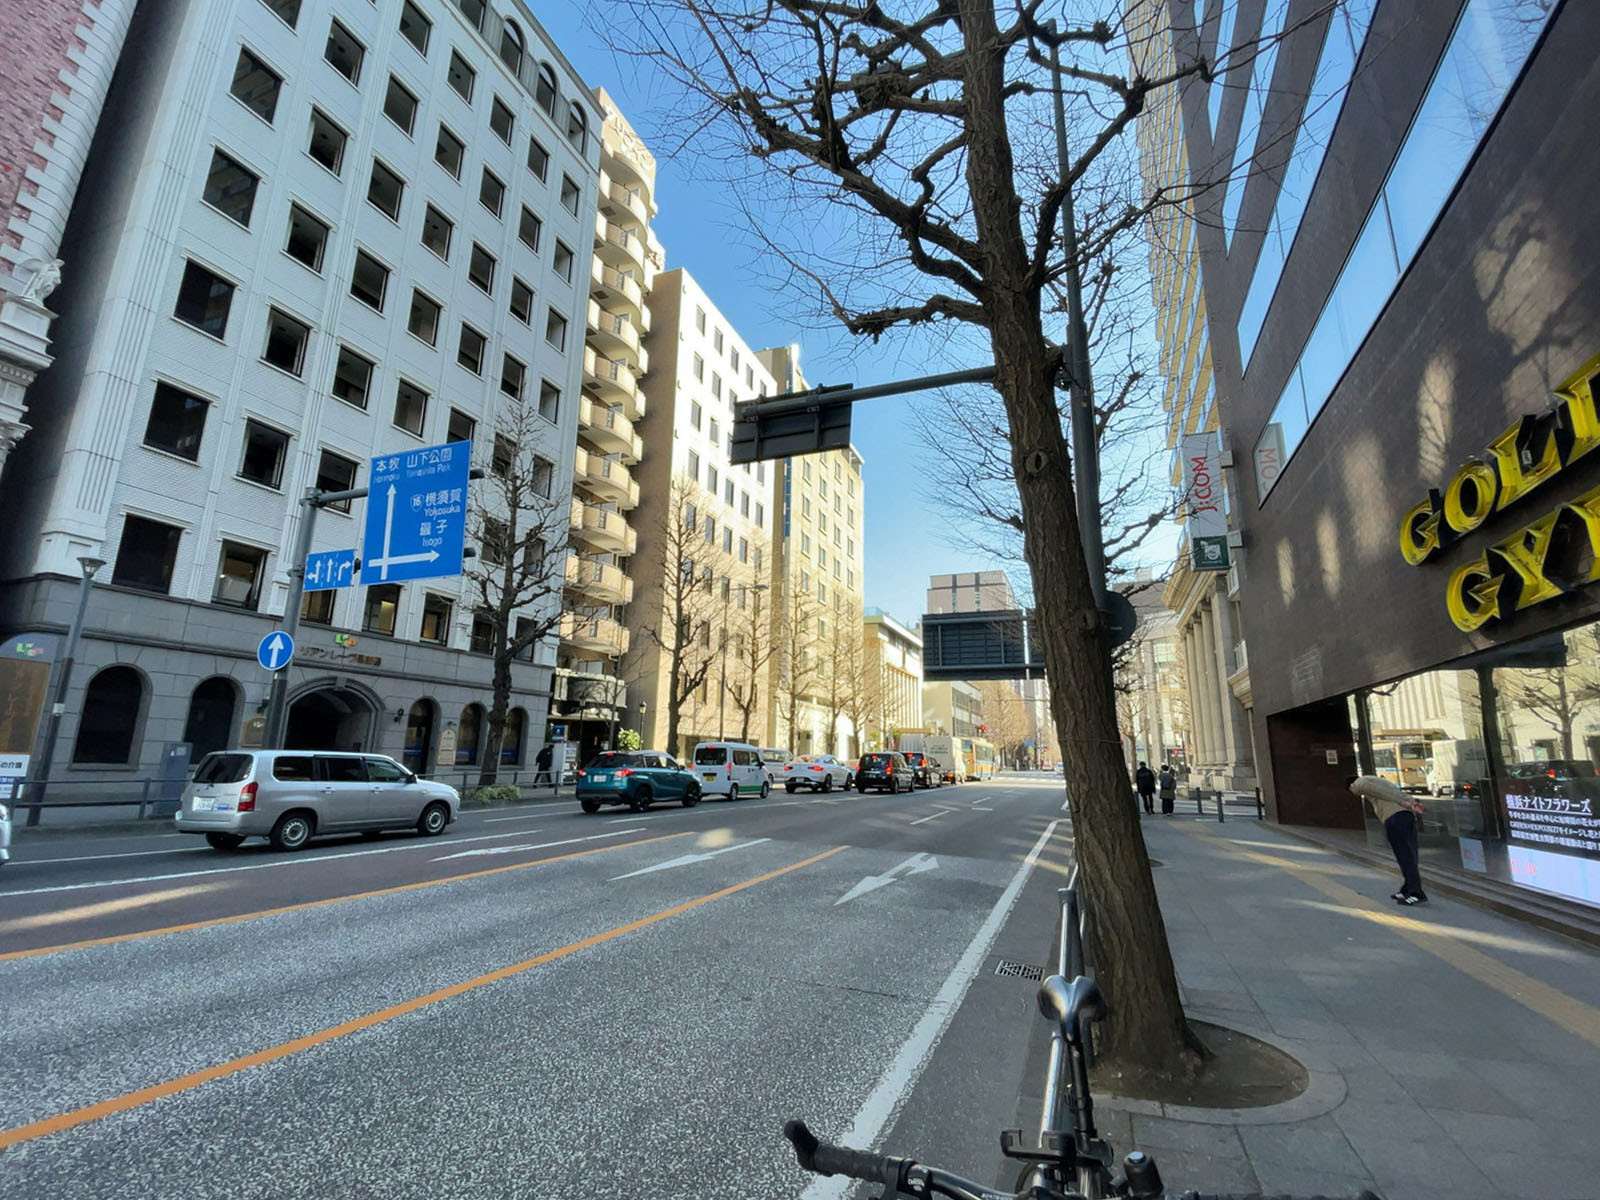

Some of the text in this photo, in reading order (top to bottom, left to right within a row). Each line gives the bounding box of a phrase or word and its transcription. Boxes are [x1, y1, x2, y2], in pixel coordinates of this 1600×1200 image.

[376, 457, 400, 472] 本牧
[407, 447, 452, 468] 山下公園
[1191, 456, 1218, 512] J:COM
[413, 496, 421, 507] 16
[425, 488, 462, 506] 横須賀
[424, 504, 461, 520] Yokosuka
